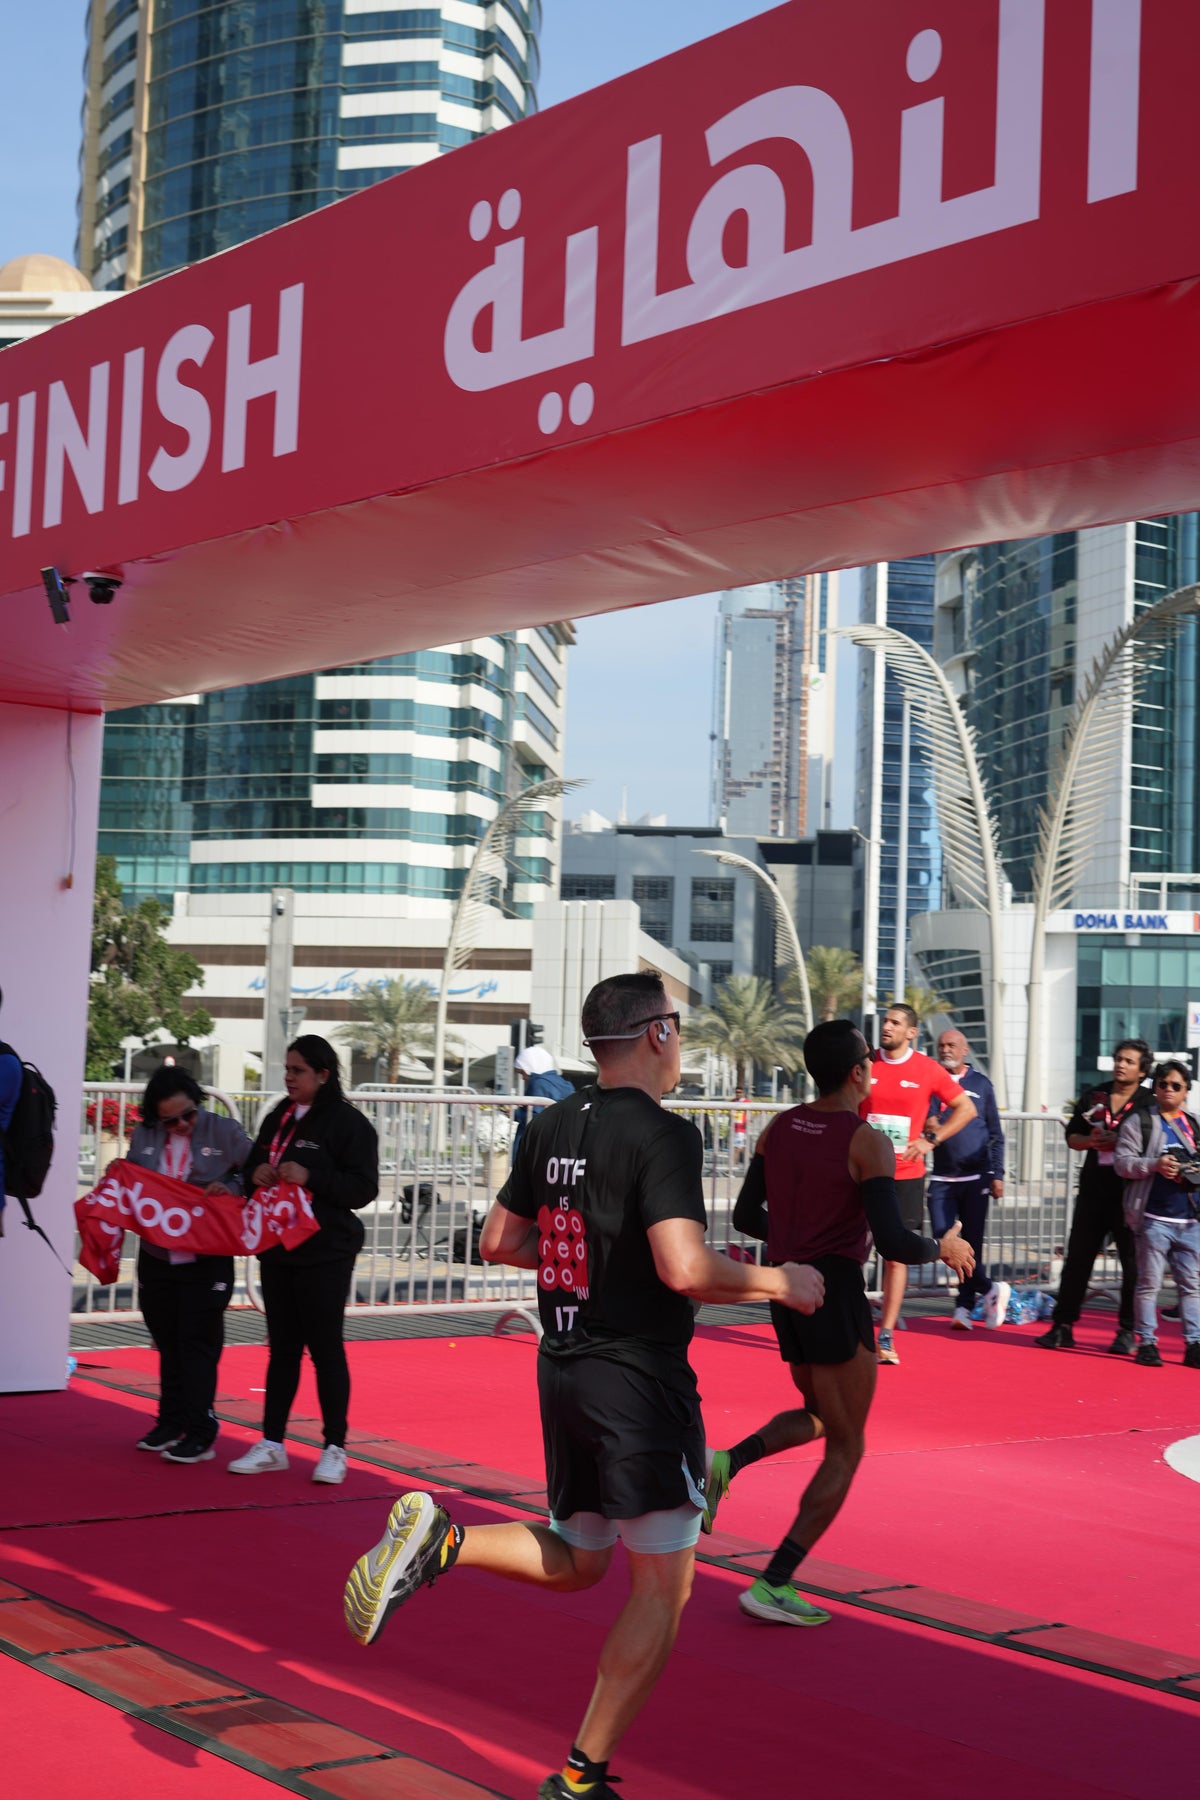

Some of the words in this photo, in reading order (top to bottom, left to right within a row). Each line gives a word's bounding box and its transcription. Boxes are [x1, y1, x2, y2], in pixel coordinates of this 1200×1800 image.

[444, 0, 1142, 435] النهاية
[1074, 913, 1119, 929] DOHA
[1123, 913, 1168, 930] BANK
[546, 1156, 587, 1186] OTF
[559, 1196, 569, 1212] IS
[555, 1306, 579, 1332] IT
